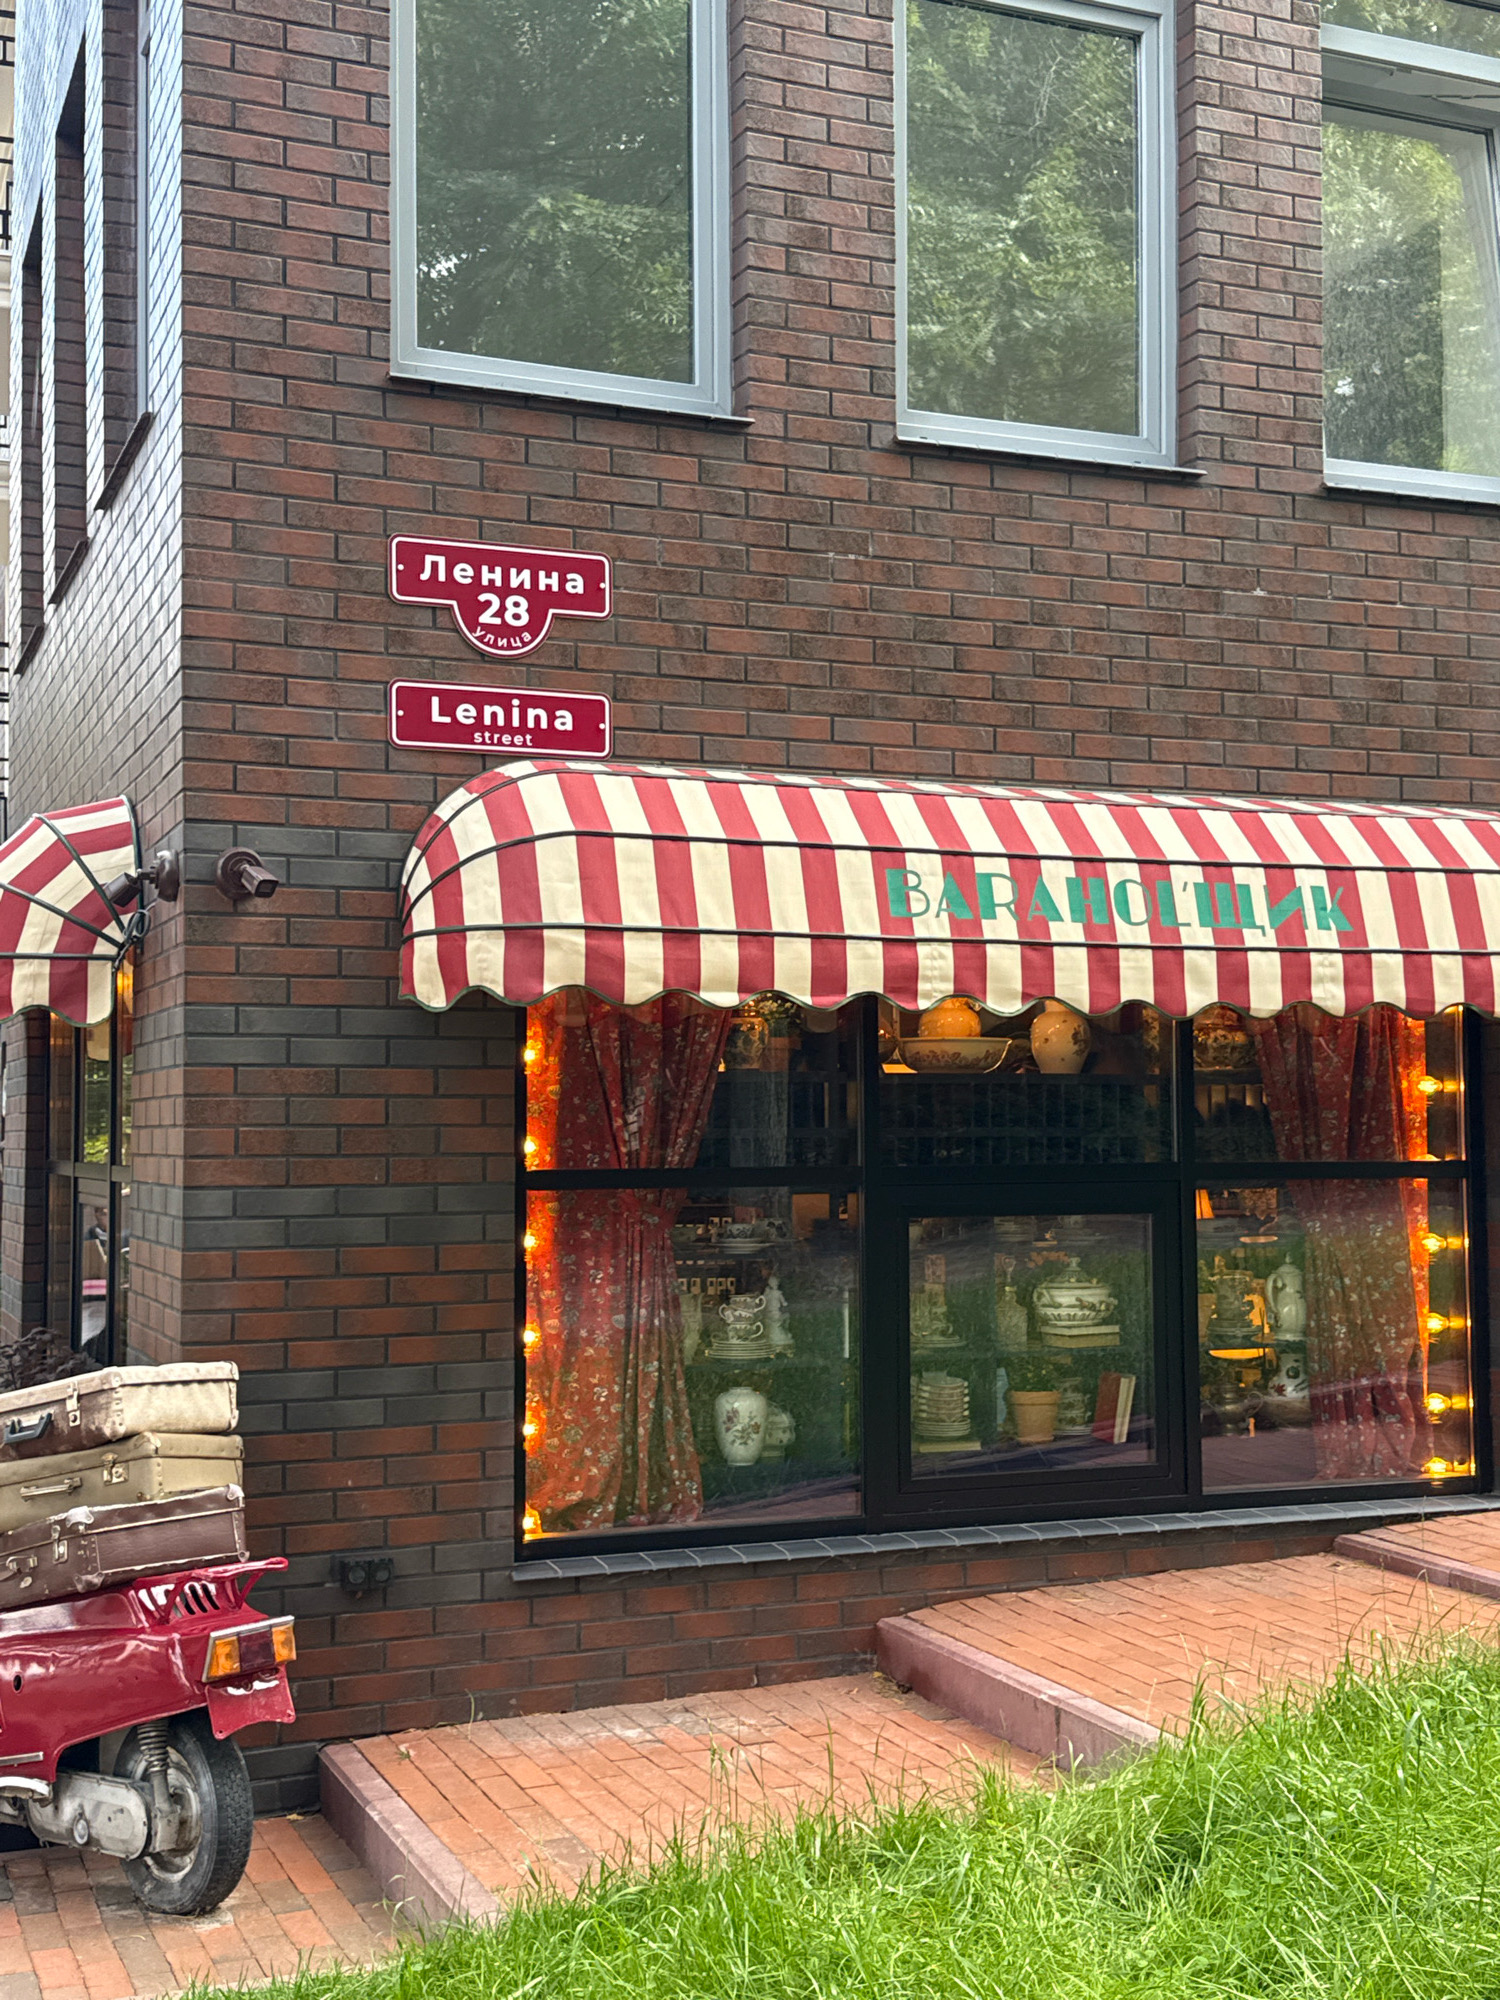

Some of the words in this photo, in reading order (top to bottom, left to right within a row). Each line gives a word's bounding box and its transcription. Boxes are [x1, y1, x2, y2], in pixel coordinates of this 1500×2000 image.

[419, 554, 585, 595] Ленина
[477, 592, 530, 627] 28
[472, 626, 532, 648] улица
[430, 695, 574, 731] Lenina
[473, 730, 533, 746] street
